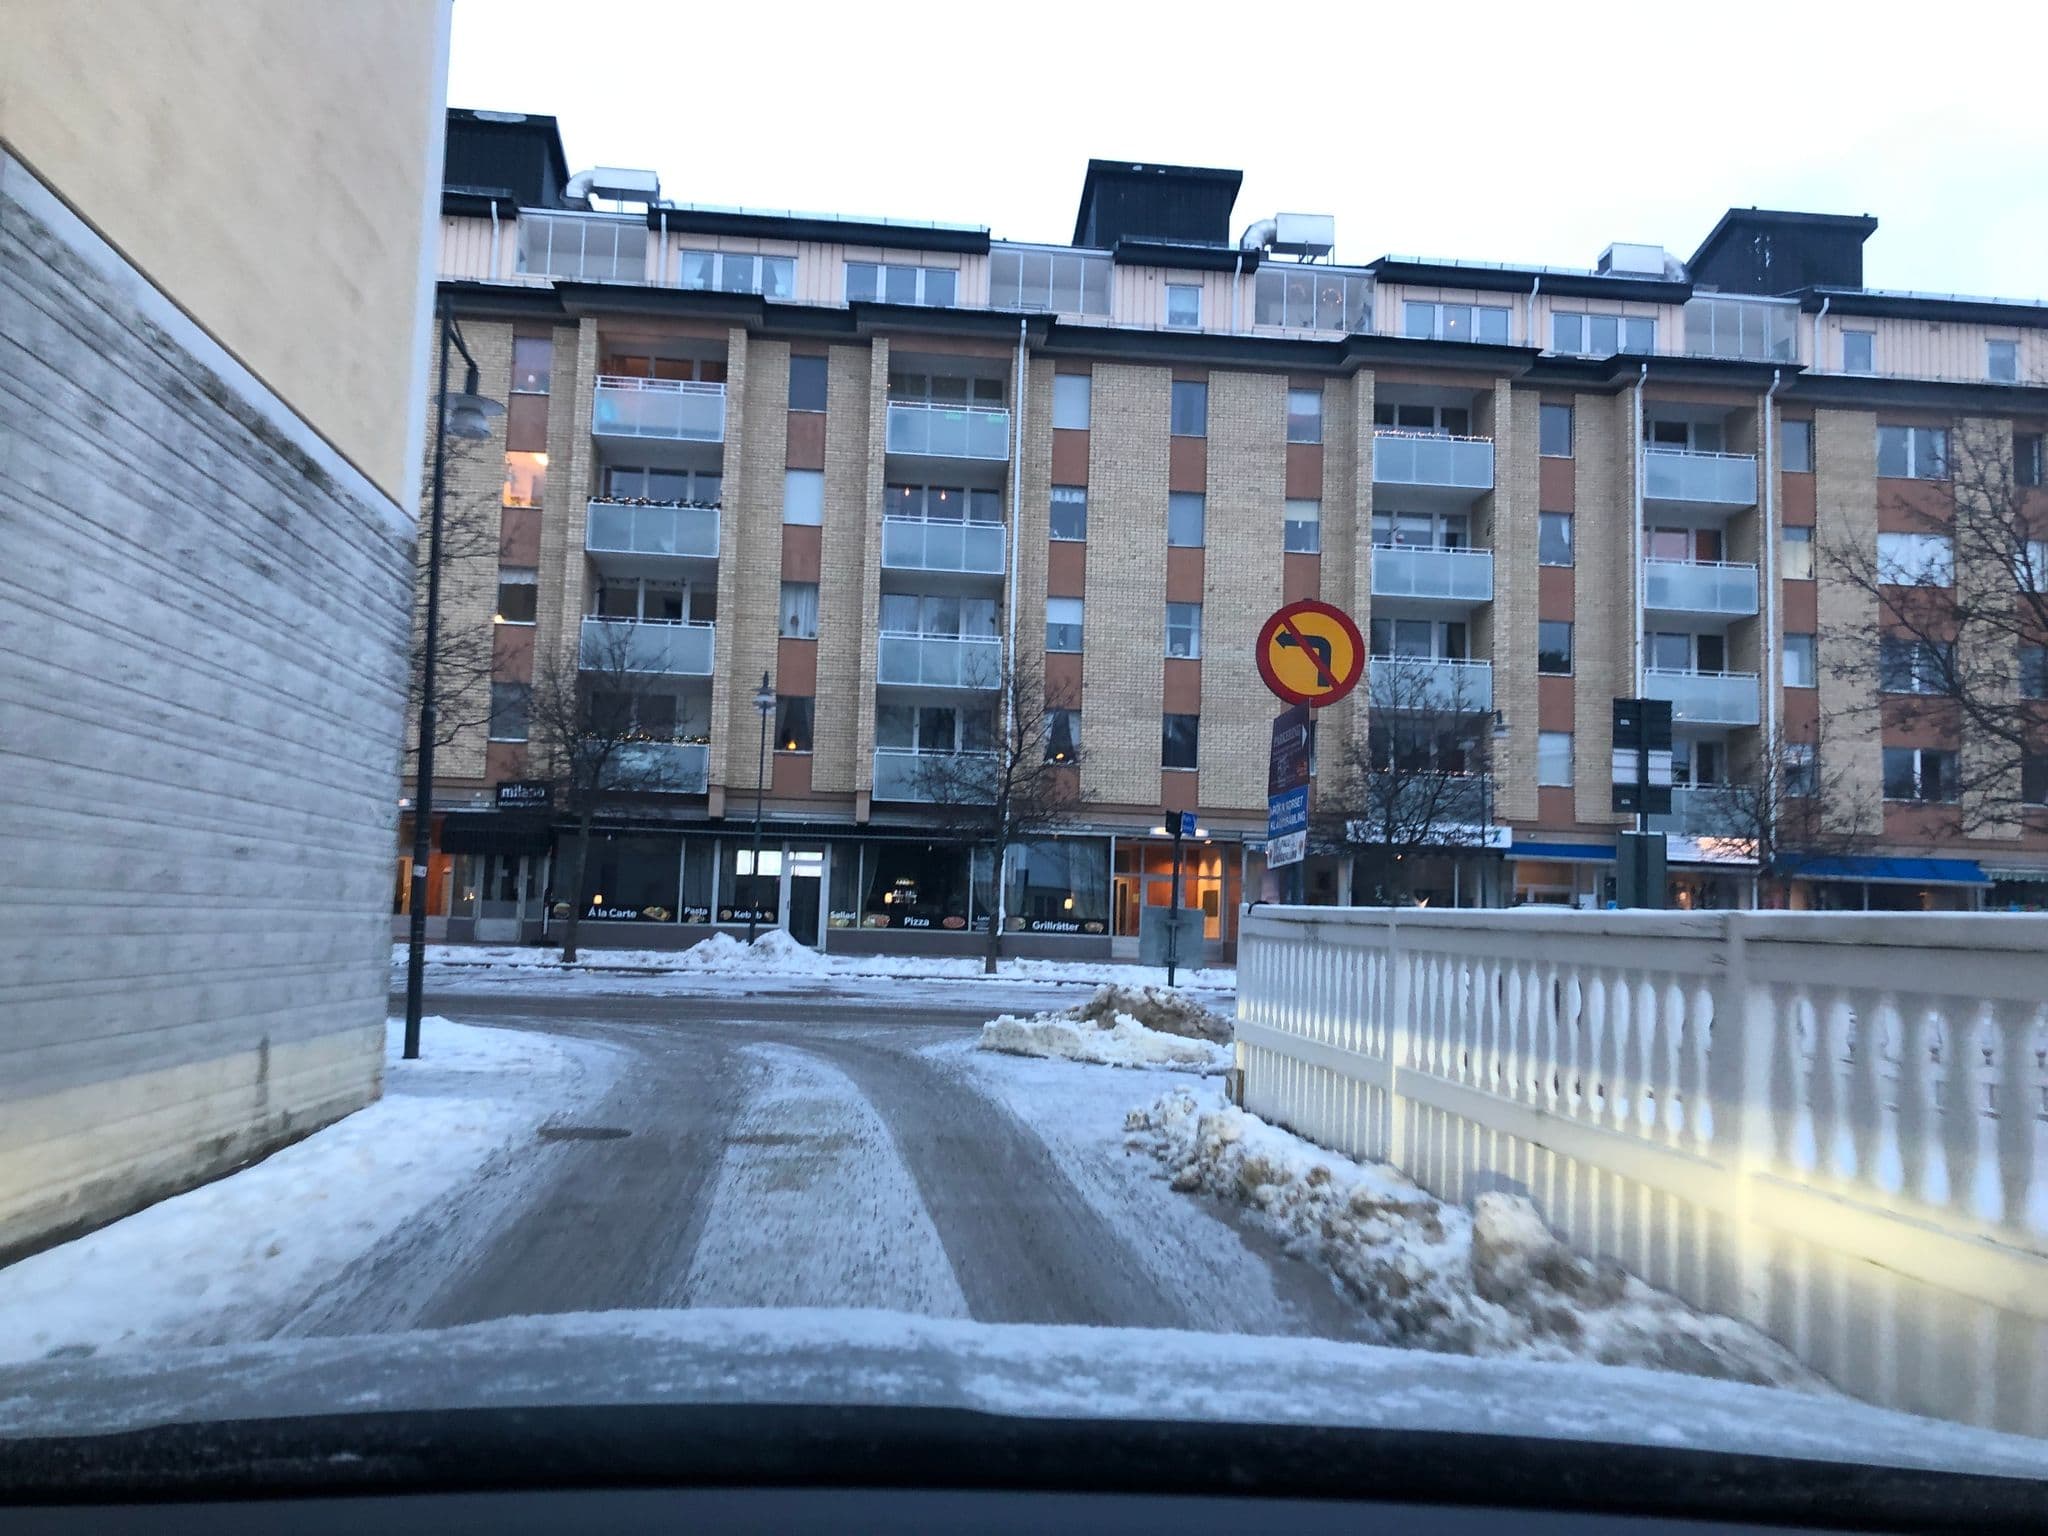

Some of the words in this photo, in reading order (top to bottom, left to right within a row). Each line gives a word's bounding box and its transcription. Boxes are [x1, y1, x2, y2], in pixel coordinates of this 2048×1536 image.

[598, 908, 607, 917] la
[609, 908, 637, 918] Carte
[684, 906, 708, 916] Pasta
[734, 910, 762, 919] Kebb
[904, 917, 930, 927] Pizza
